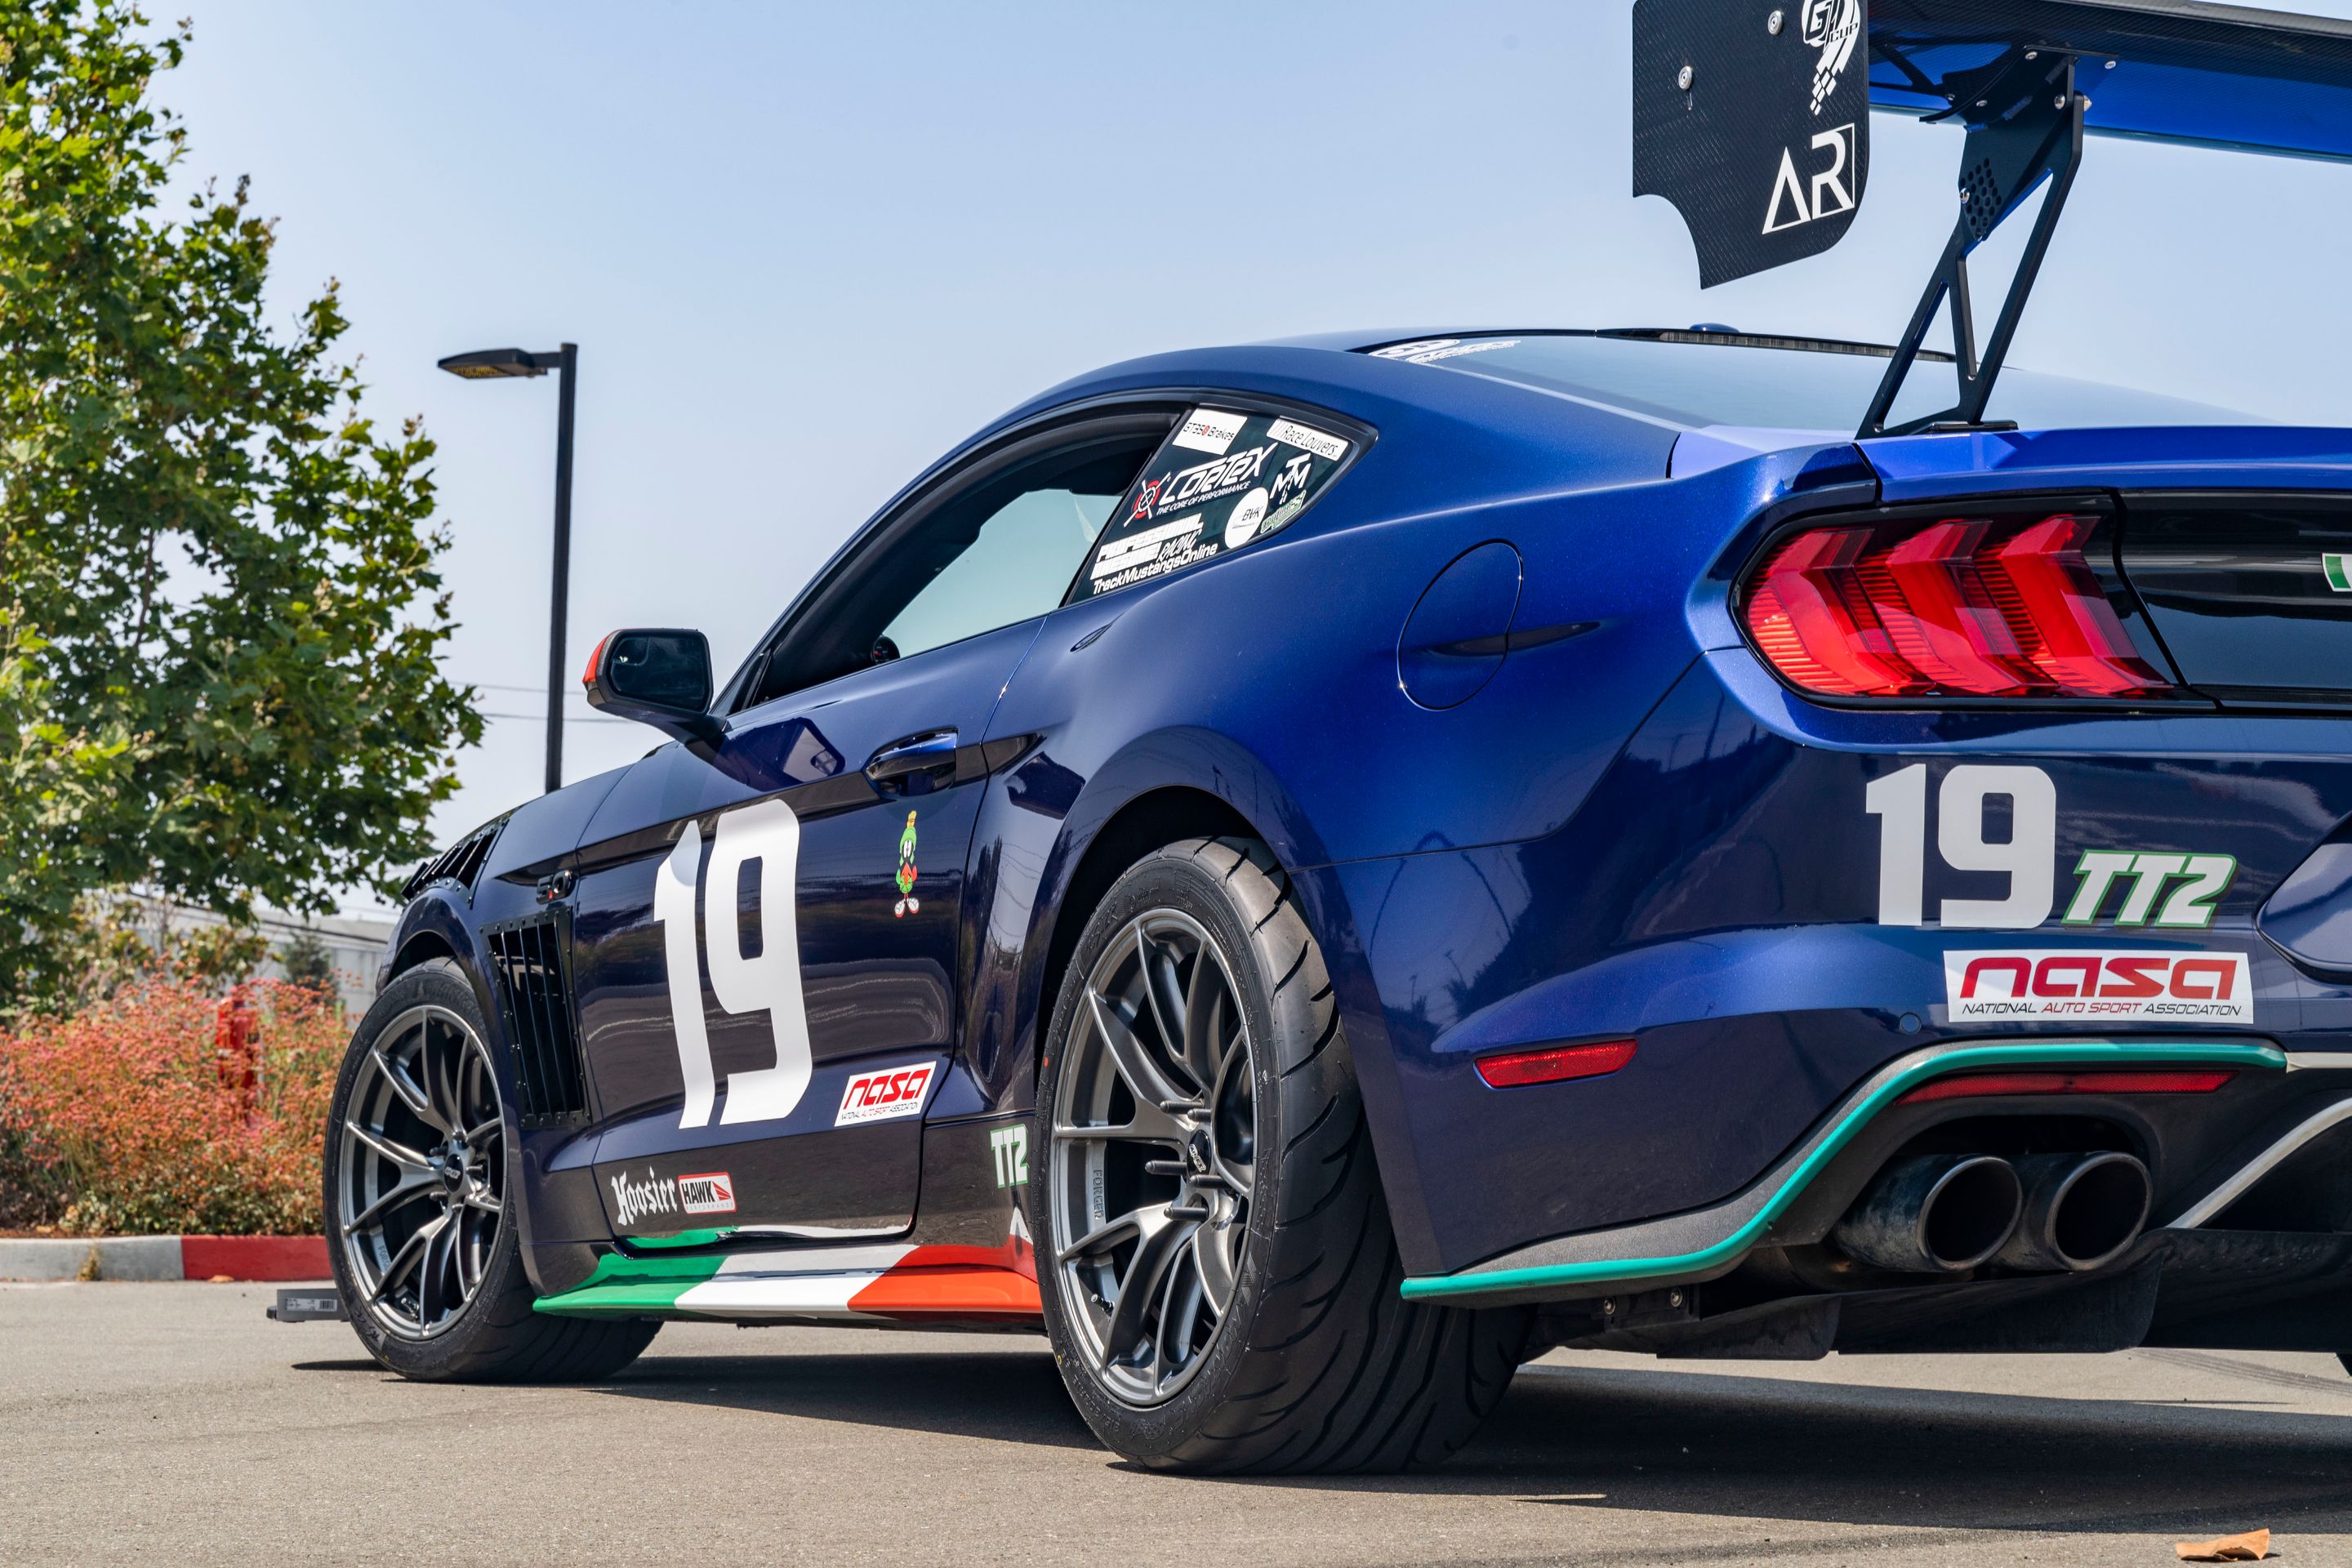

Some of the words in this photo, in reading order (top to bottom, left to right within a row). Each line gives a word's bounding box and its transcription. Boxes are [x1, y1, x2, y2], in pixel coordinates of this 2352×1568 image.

[1829, 23, 1859, 43] CUP
[1762, 122, 1855, 235] AR
[1207, 426, 1236, 442] Brakes
[1282, 425, 1303, 443] Race
[1300, 433, 1339, 457] Louvers
[1156, 505, 1170, 515] THE
[1169, 499, 1188, 512] CORE
[1187, 497, 1199, 508] OF
[1196, 481, 1251, 505] PERFORMANCE
[1093, 542, 1218, 595] TrackMustangsOnline
[1865, 763, 2057, 929] 19
[536, 870, 573, 904] 5.0
[2061, 849, 2238, 929] TT2
[653, 799, 813, 1130] 19
[1962, 1002, 2038, 1014] NATIONAL
[2041, 1002, 2086, 1013] AUTO
[2087, 1002, 2143, 1014] SPORT
[2143, 1003, 2243, 1017] ASSOCIATION
[990, 1123, 1029, 1189] TT2
[611, 1165, 678, 1227] Hoosier
[680, 1180, 715, 1205] HAWK
